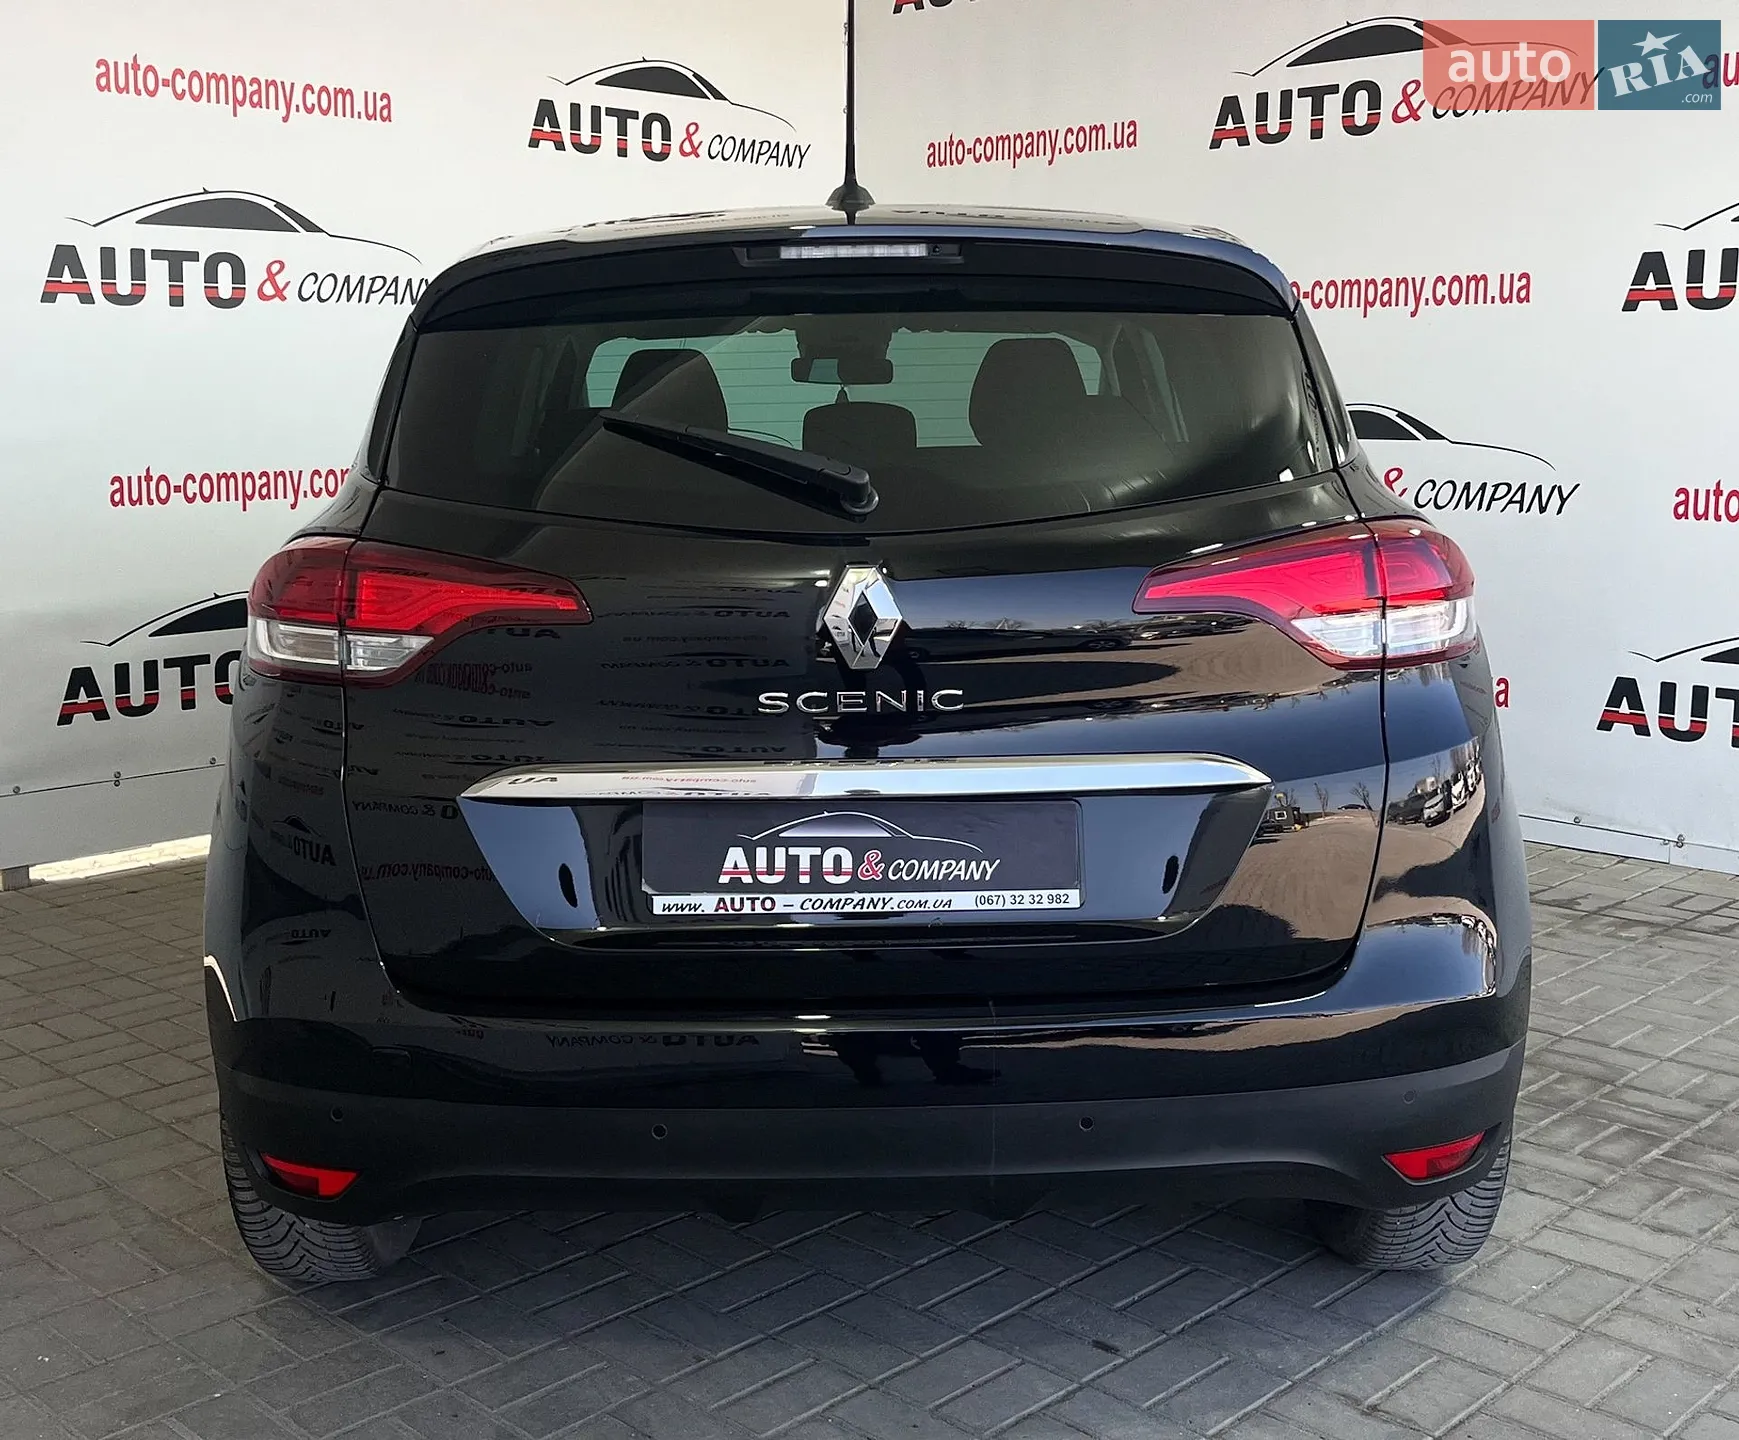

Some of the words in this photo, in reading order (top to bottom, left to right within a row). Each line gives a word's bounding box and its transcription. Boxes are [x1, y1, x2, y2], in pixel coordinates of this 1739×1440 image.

[96, 54, 392, 123] auto-company.com.ua
[1209, 80, 1382, 149] AUTO
[1391, 79, 1426, 123] &
[1432, 67, 1604, 119] COMPANY
[529, 98, 672, 162] AUTO
[679, 122, 702, 158] &
[707, 134, 811, 169] COMPANY
[927, 119, 1138, 168] auto-company.com.ua
[40, 244, 246, 309] AUTO
[257, 259, 290, 302] &
[1621, 247, 1739, 311] AU
[1413, 479, 1580, 516] COMPANY
[1673, 479, 1739, 522] auto
[57, 650, 242, 726] AUTO
[757, 689, 965, 714] SCENIC
[718, 846, 853, 884] AUTO
[858, 850, 885, 880] &
[888, 859, 1000, 881] COMPANY
[662, 902, 705, 913] www.
[714, 896, 776, 913] AUTO
[974, 894, 1006, 909] (067)
[1010, 894, 1025, 906] 32
[1028, 894, 1044, 905] 32
[1047, 893, 1070, 905] 982
